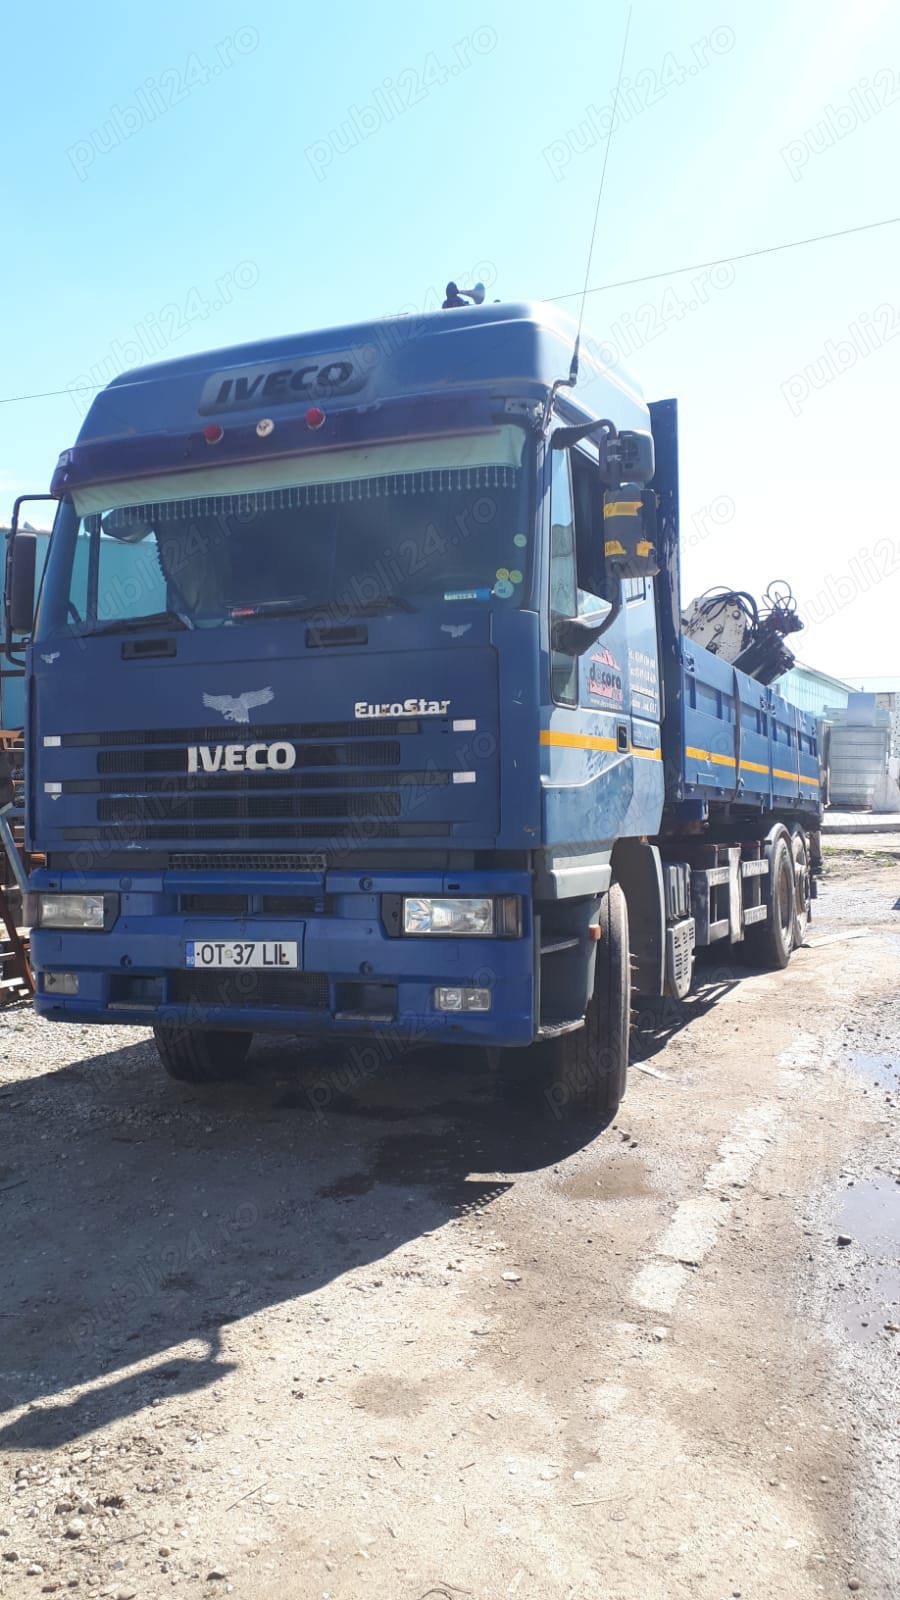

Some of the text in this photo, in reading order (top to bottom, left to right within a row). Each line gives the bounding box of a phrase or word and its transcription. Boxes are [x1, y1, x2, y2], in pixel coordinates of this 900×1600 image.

[216, 361, 354, 403] IVECO
[354, 699, 451, 718] EuroStar
[187, 741, 296, 773] IVECO
[201, 943, 225, 965] OT
[233, 943, 255, 965] 37
[262, 943, 290, 965] LIL
